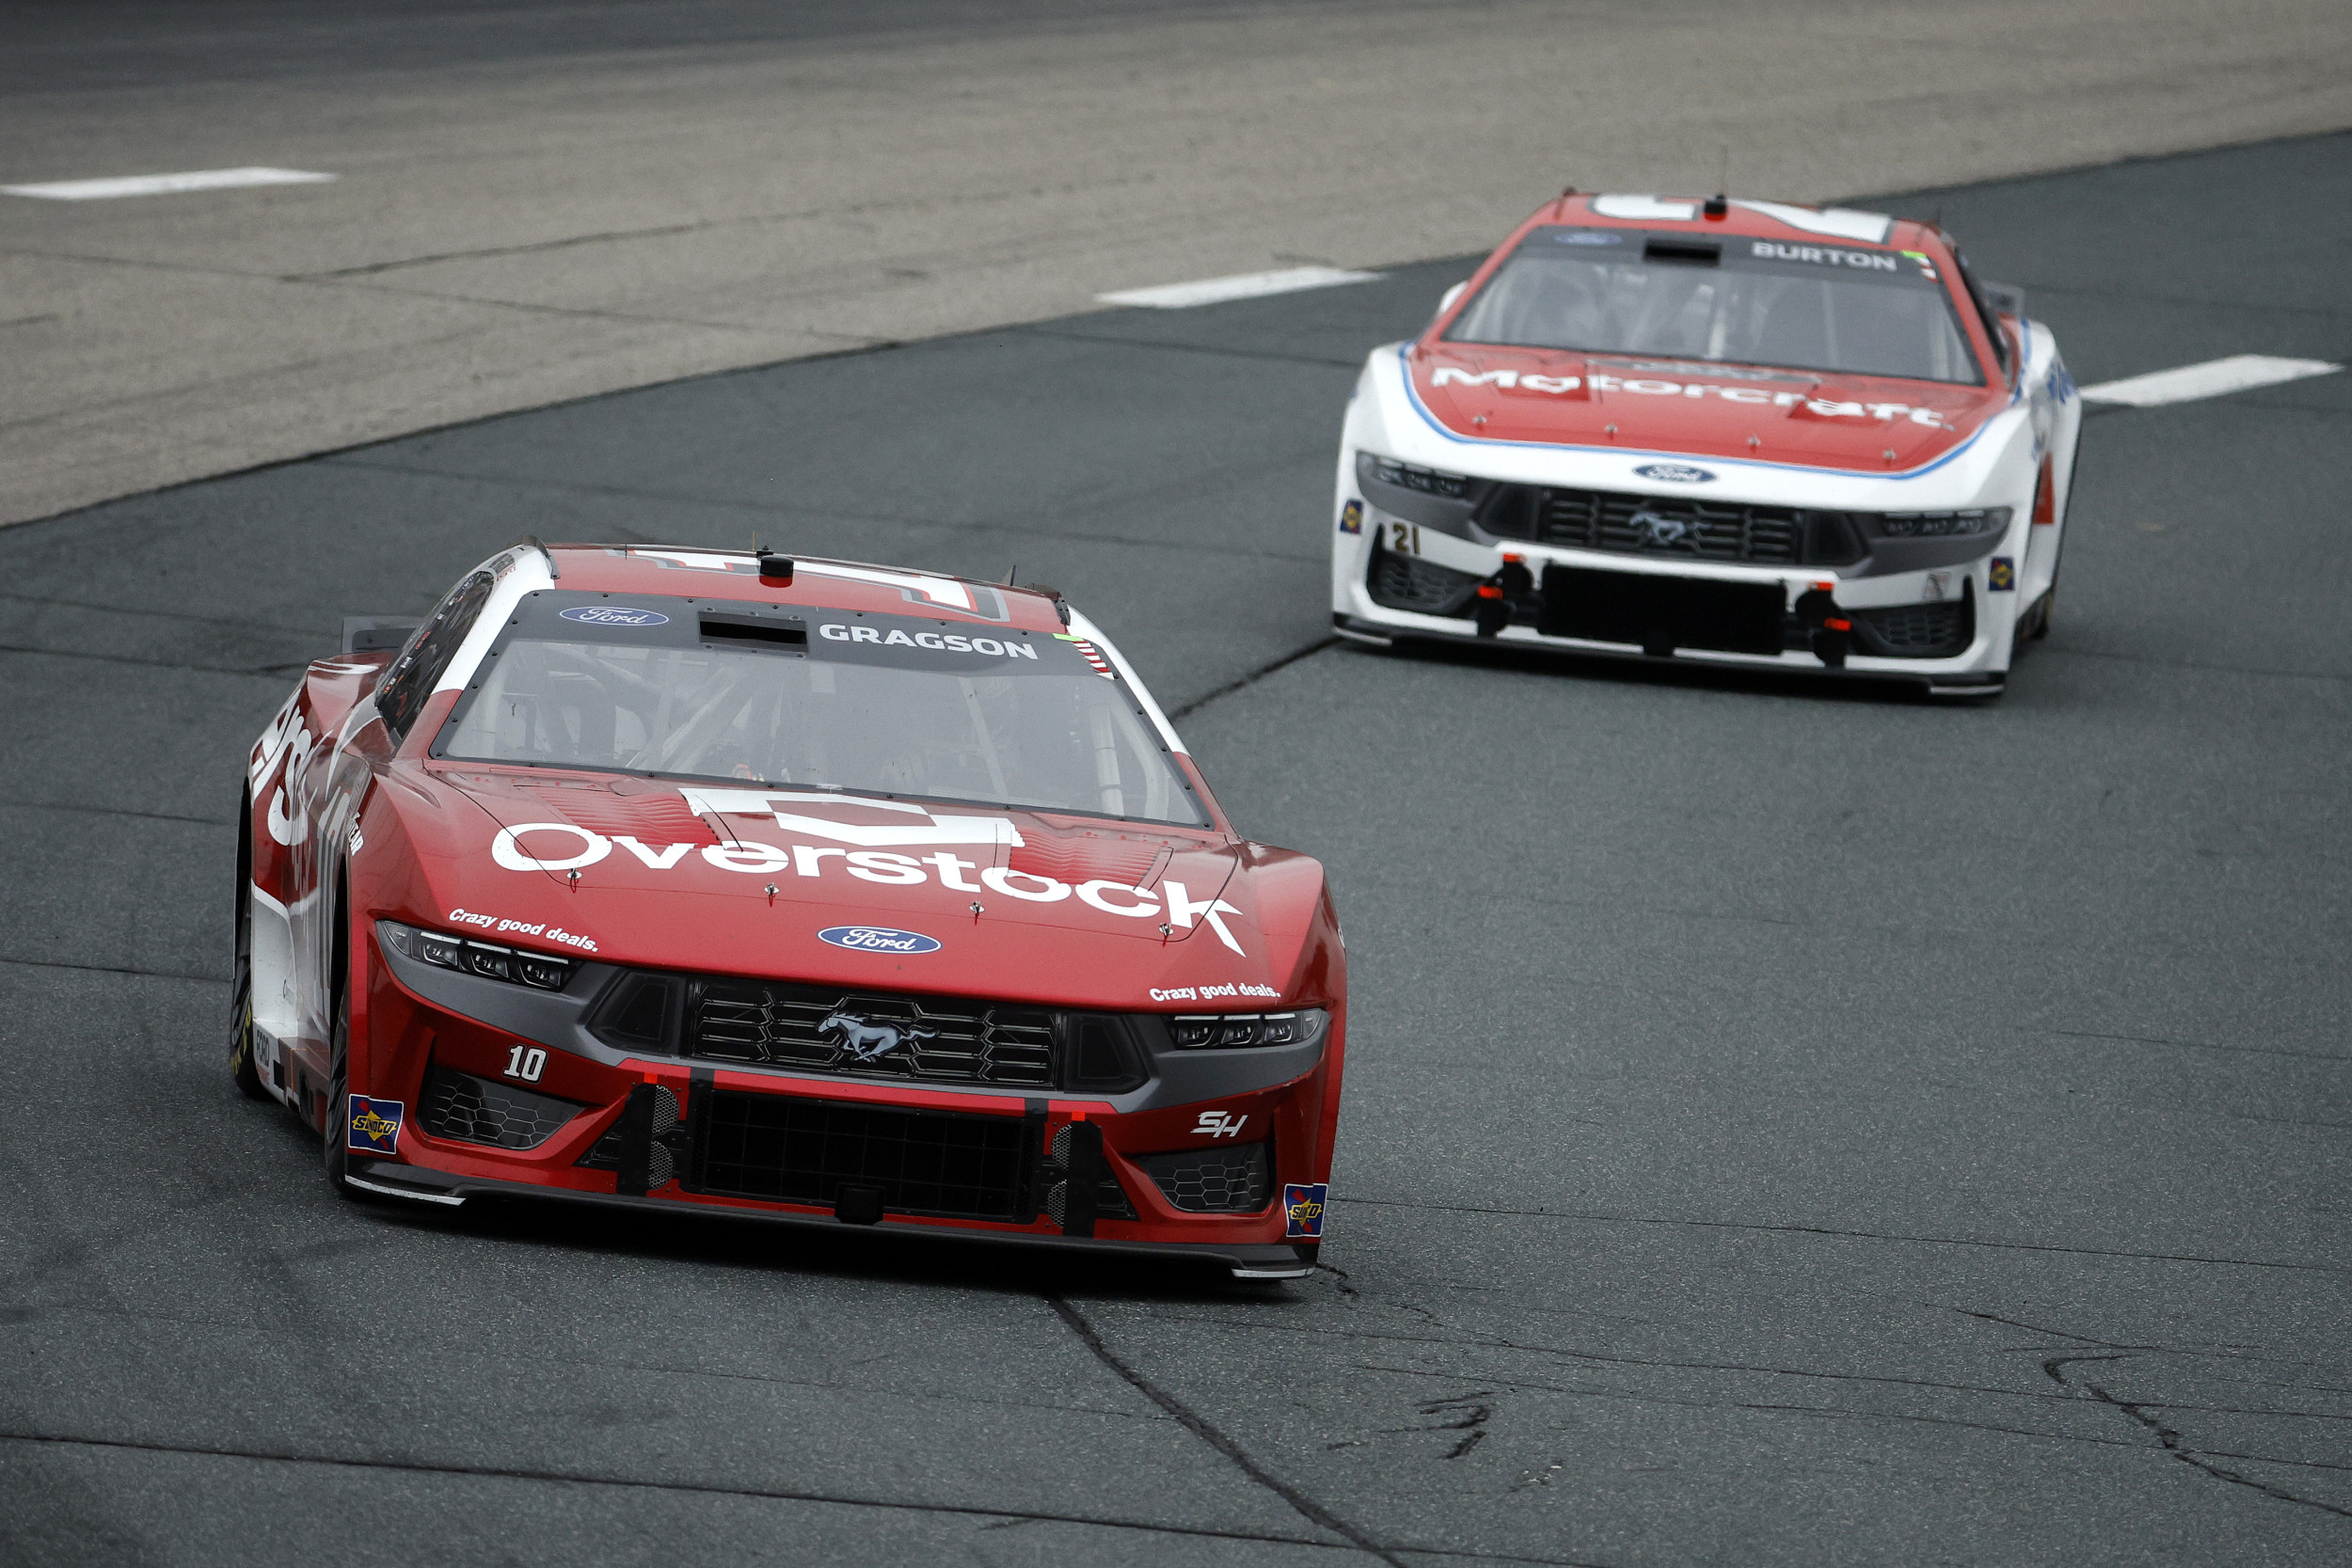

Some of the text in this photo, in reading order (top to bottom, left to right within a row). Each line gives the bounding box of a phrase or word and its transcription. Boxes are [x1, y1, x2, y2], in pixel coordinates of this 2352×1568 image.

[1753, 242, 1898, 271] BURTON
[1431, 367, 1956, 432] Motorcraft
[1393, 523, 1421, 555] 21
[818, 624, 1039, 660] GRAGSON
[491, 822, 1247, 958] Overstock
[449, 908, 599, 953] Crazy good deals.
[841, 927, 917, 951] Ford
[1149, 982, 1281, 1002] Crazy good deals.
[503, 1045, 547, 1082] 10
